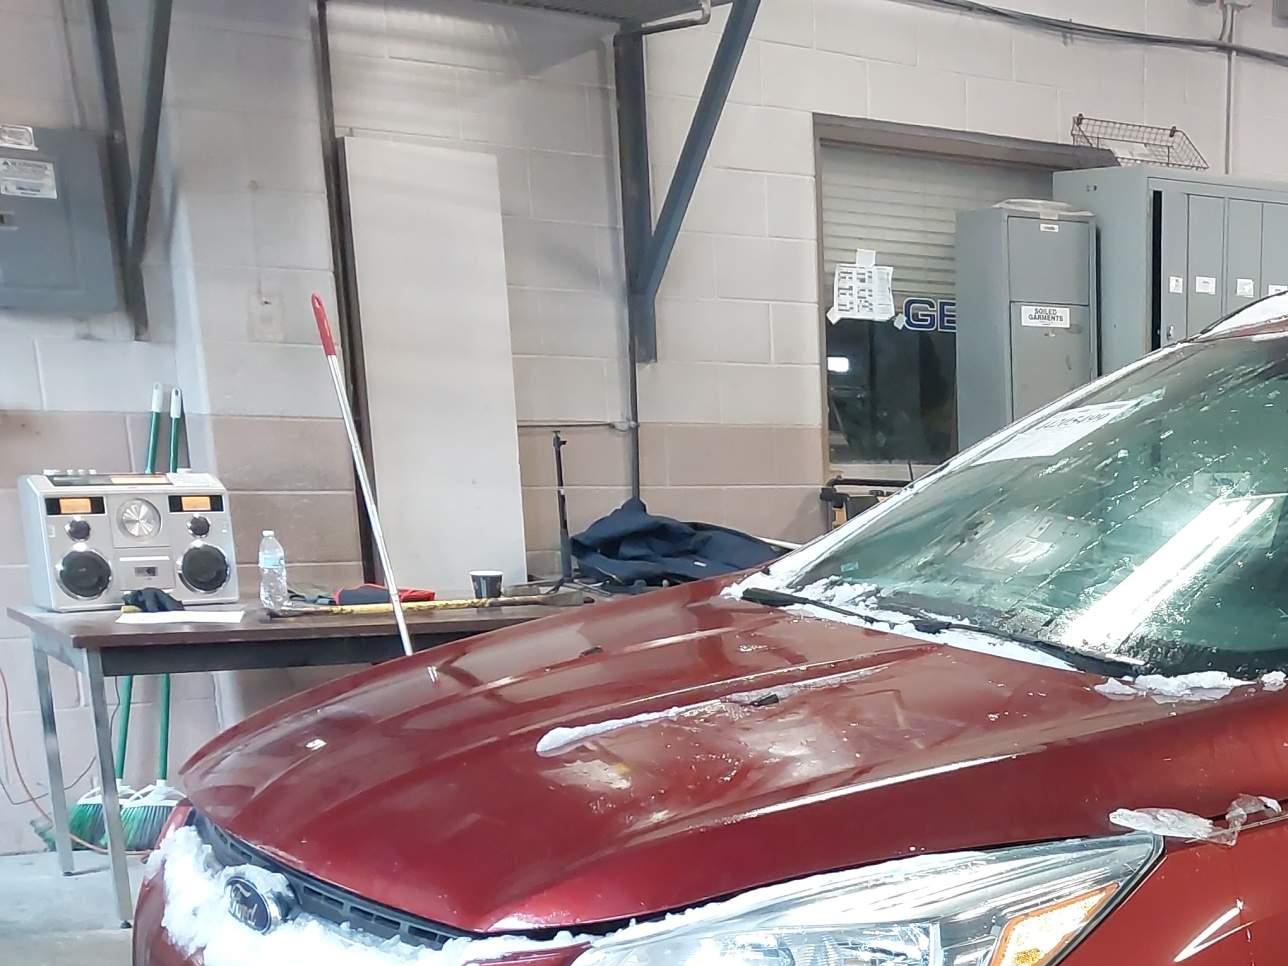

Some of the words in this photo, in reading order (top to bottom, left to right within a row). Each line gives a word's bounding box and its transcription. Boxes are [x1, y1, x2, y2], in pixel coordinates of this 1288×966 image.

[903, 297, 957, 332] GE
[1034, 307, 1057, 315] SOILED
[1028, 314, 1064, 322] GARMENTS
